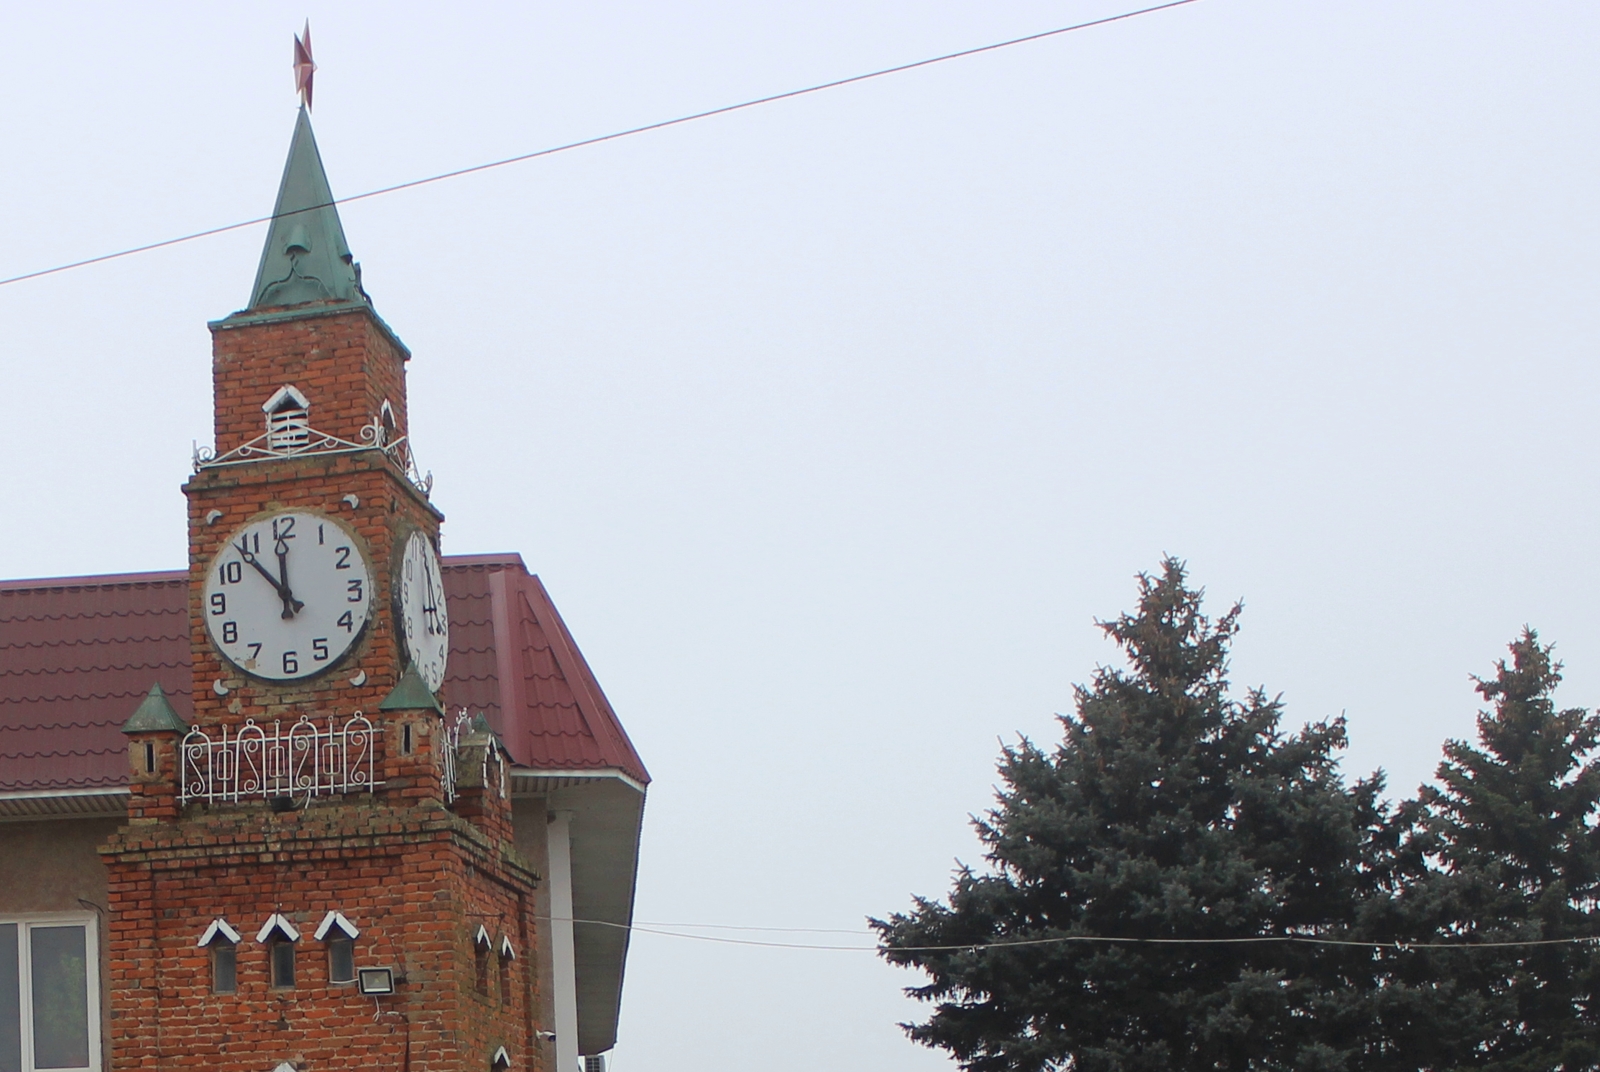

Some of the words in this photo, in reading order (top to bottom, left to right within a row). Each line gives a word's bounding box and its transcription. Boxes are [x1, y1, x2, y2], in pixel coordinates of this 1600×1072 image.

[272, 516, 296, 540] 12
[318, 523, 324, 545] 1
[241, 532, 261, 554] 11
[335, 546, 350, 570] 2
[219, 561, 242, 585] 10
[347, 579, 363, 602] 3
[403, 582, 409, 604] 9
[437, 583, 443, 606] 2
[211, 592, 226, 616] 9
[222, 621, 238, 644] 8
[337, 610, 354, 633] 4
[407, 616, 413, 639] 8
[441, 614, 447, 637] 3
[247, 642, 263, 660] 7
[312, 638, 329, 661] 5
[438, 644, 445, 666] 4
[282, 651, 299, 674] 6
[431, 661, 438, 684] 5
